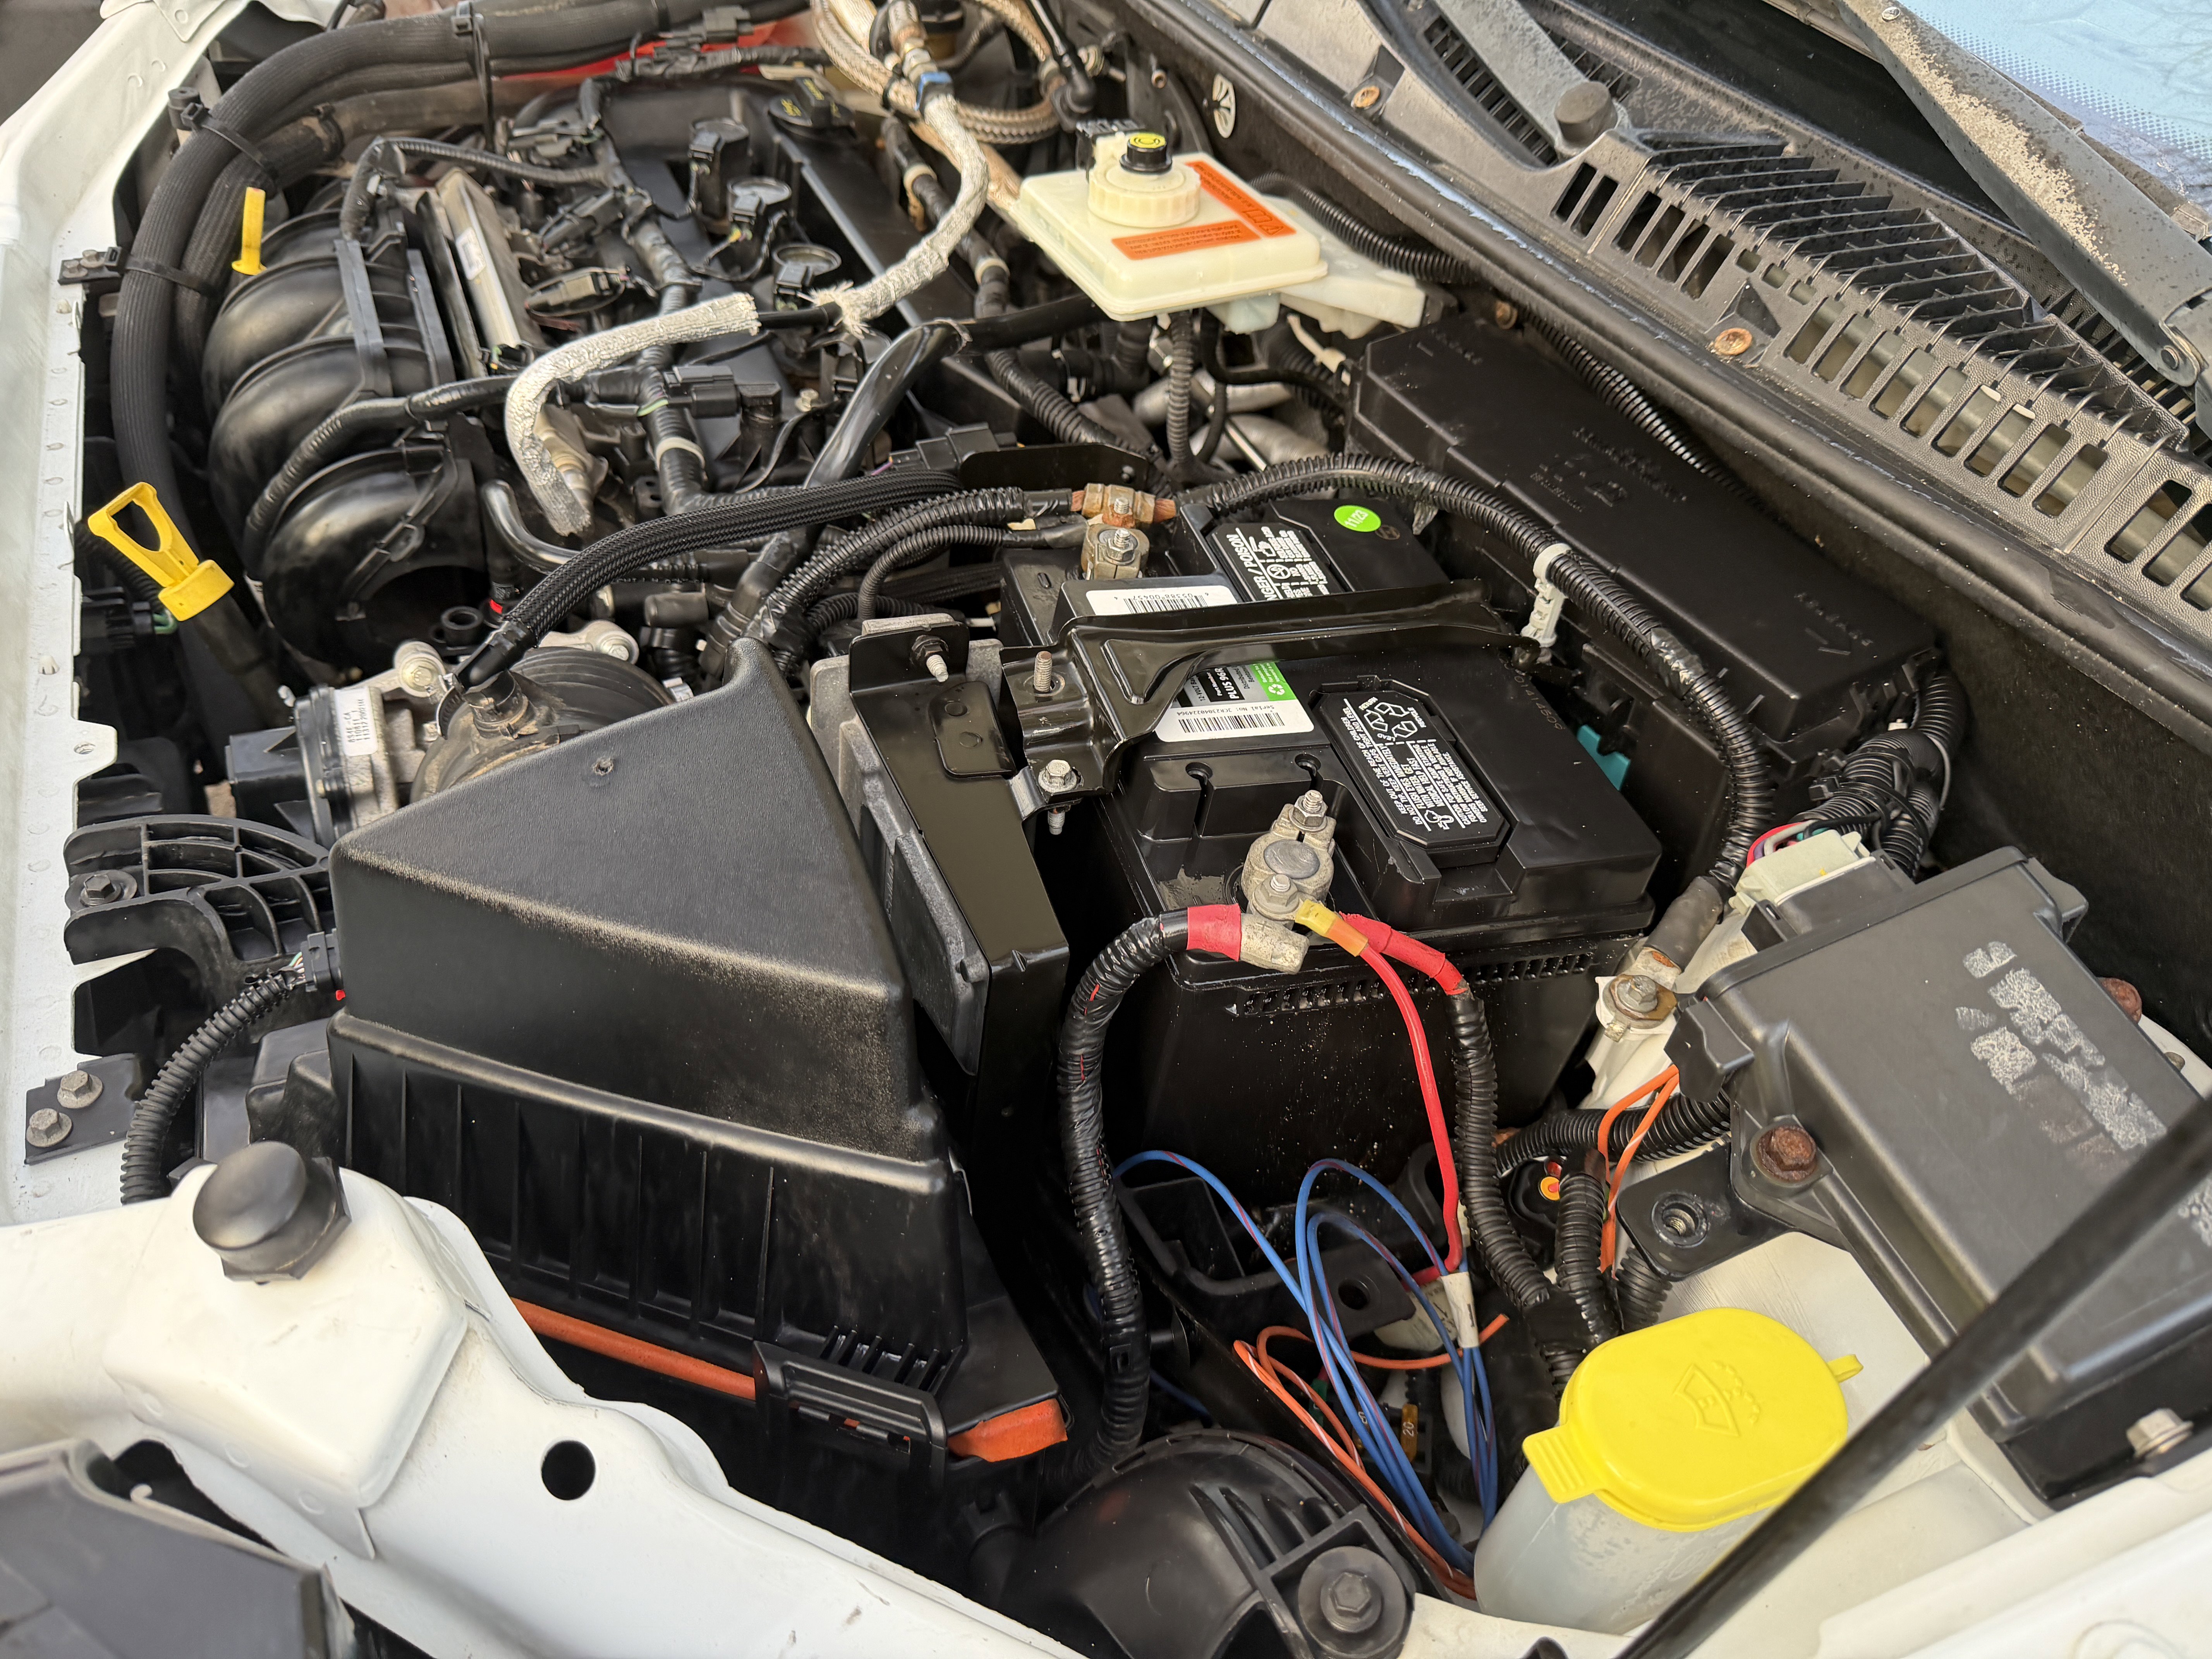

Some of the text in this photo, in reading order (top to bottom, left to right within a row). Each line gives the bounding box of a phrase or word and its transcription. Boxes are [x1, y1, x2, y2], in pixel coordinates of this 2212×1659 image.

[1345, 509, 1369, 527] 11/23
[1226, 534, 1257, 568] POISON
[1289, 567, 1301, 577] NO
[1254, 575, 1278, 601] NGER
[1207, 672, 1218, 687] Number
[1215, 668, 1239, 699] PLUS 96R
[1232, 668, 1250, 689] Distributed
[1192, 686, 1205, 701] 12-VOLT
[1359, 697, 1378, 710] RETURN
[1408, 708, 1426, 728] RECYCLE
[1341, 717, 1360, 740] CHILDREN
[1352, 722, 1363, 732] AND
[1359, 733, 1373, 748] TIGHT
[1362, 750, 1377, 766] REACH
[1369, 749, 1382, 762] CAPS
[1413, 744, 1431, 766] STARTING
[1421, 745, 1437, 764] VEHICLE
[1428, 743, 1448, 765] AVAILABLE
[1373, 768, 1384, 778] THE
[1378, 764, 1391, 777] VENT
[1401, 764, 1413, 774] GET
[1427, 766, 1441, 780] JUMP
[1443, 766, 1456, 776] NOT
[1379, 745, 1426, 809] FLUSH EYES IMMEDIATELY
[1388, 778, 1401, 791] KEEP
[1407, 758, 1445, 807] MEDICAL HELP FAST
[1386, 788, 1398, 799] OUT
[1436, 780, 1449, 792] SAFE
[1437, 769, 1464, 803] INSTRUCTIONS
[1461, 781, 1479, 799] SERVICE
[1418, 791, 1435, 808] WITH
[1444, 793, 1455, 803] FOR
[1394, 800, 1408, 814] KEEP
[1404, 804, 1416, 815] NOT
[1460, 804, 1478, 822] FOLLOW
[1474, 800, 1488, 812] SEEK
[1403, 1422, 1414, 1437] 20
